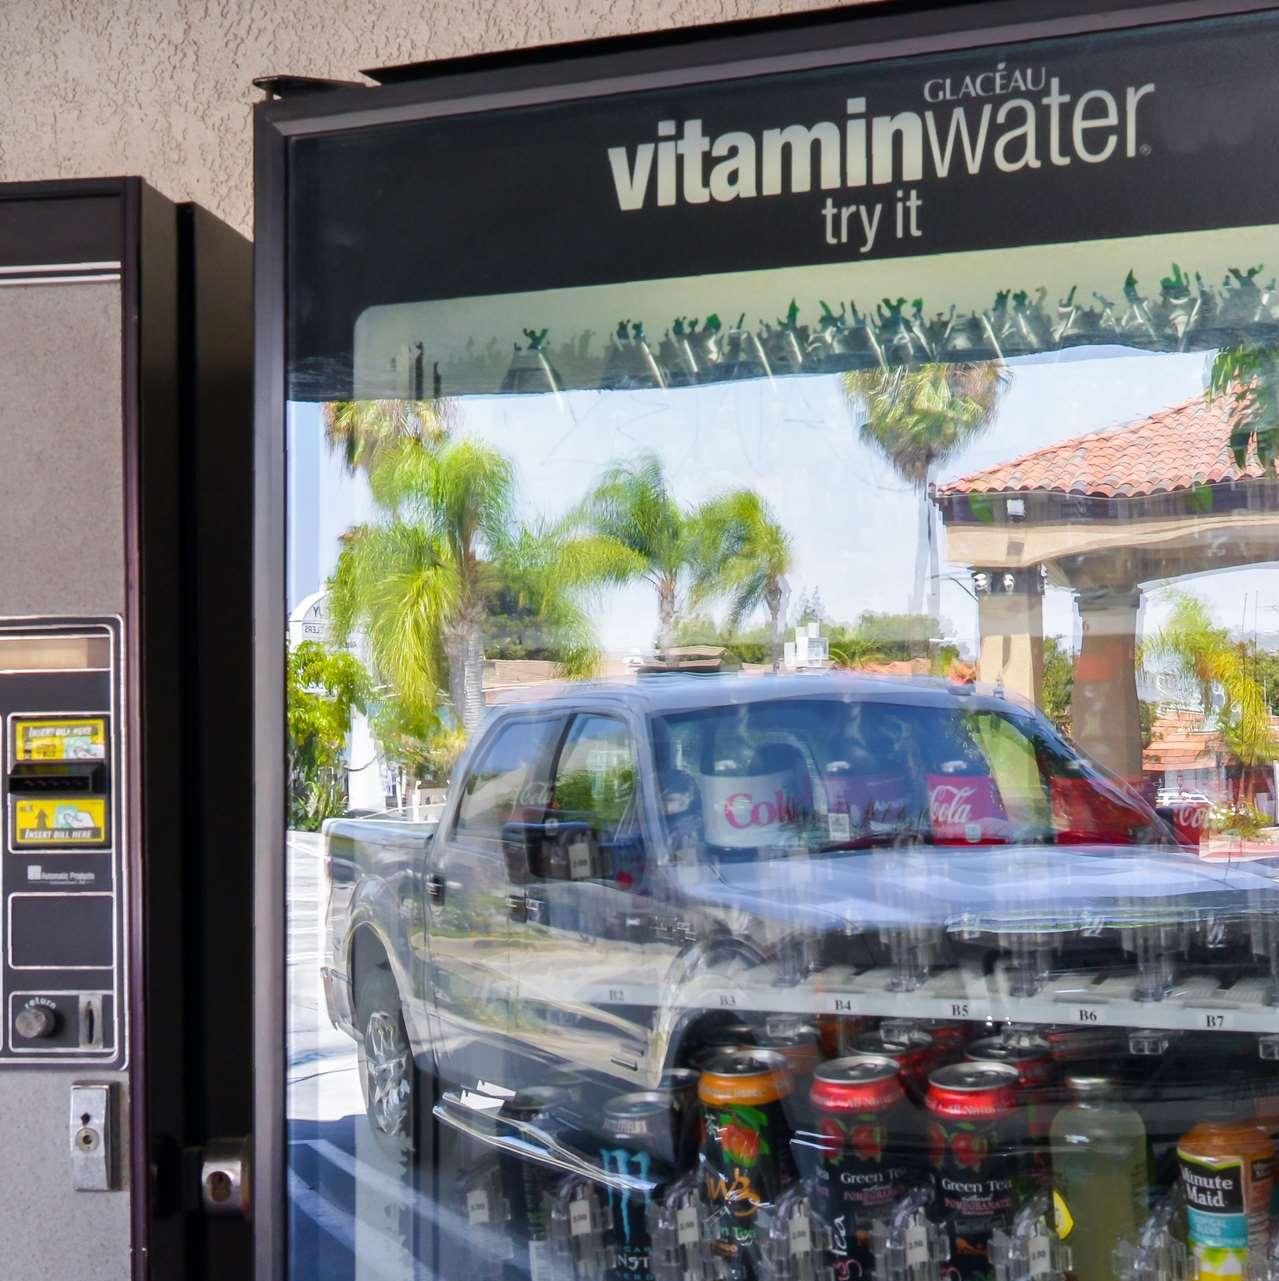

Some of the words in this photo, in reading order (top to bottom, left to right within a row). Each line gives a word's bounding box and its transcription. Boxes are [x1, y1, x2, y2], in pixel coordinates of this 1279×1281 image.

[924, 63, 1047, 103] GLACÉAU
[822, 197, 881, 253] try
[896, 189, 923, 239] it
[25, 829, 52, 839] INSERT
[24, 997, 57, 1010] return
[834, 1000, 851, 1012] B4
[951, 1004, 968, 1016] B5
[1079, 1009, 1097, 1022] B6
[1206, 1015, 1224, 1028] B7
[840, 1171, 884, 1184] Green
[1180, 1164, 1233, 1190] Minute
[942, 1178, 982, 1193] Green
[989, 1178, 1012, 1190] Tea
[1186, 1184, 1226, 1207] Maid
